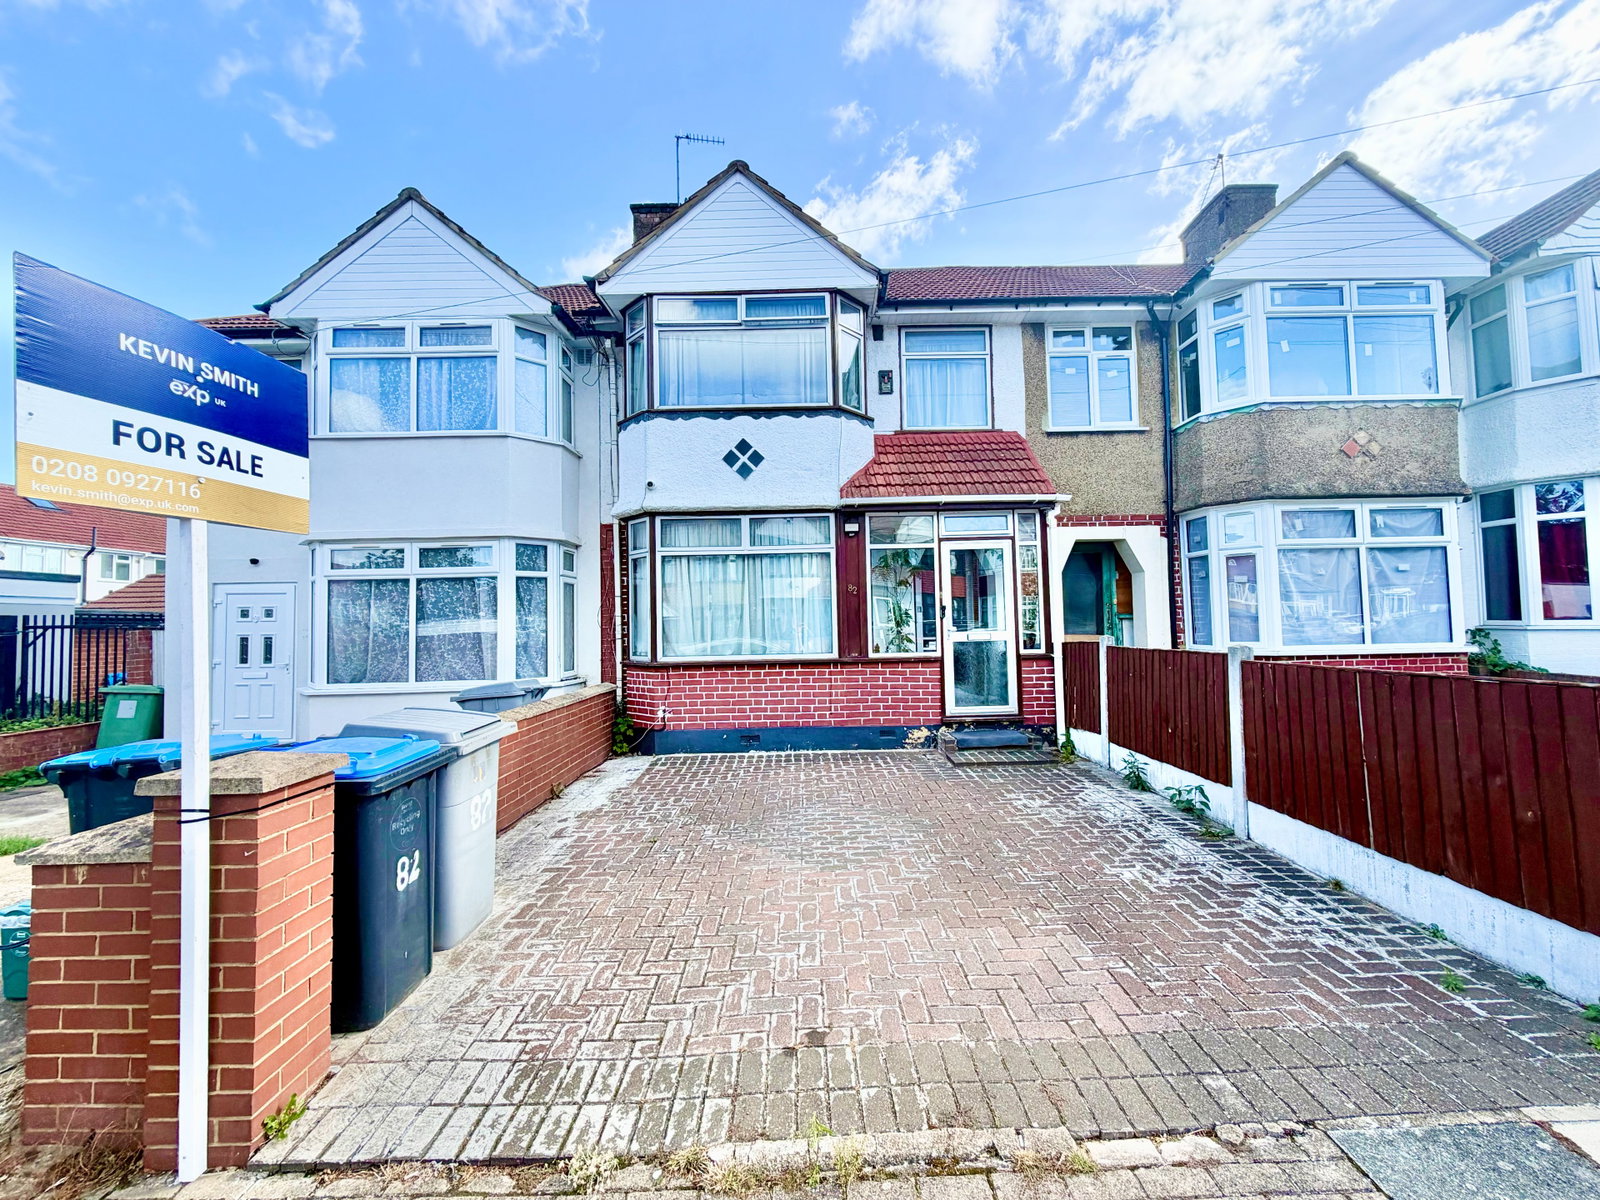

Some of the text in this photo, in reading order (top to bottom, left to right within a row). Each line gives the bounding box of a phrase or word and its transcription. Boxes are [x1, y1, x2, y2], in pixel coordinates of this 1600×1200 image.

[119, 332, 259, 398] KEVIN SMITH
[169, 379, 227, 407] exp UK
[112, 419, 263, 478] FOR SALE
[31, 455, 201, 499] 0208 0927116
[31, 480, 200, 513] kevin.smith@exp.uk.com
[847, 583, 858, 594] 82
[470, 788, 492, 831] 82
[396, 849, 420, 891] 82
